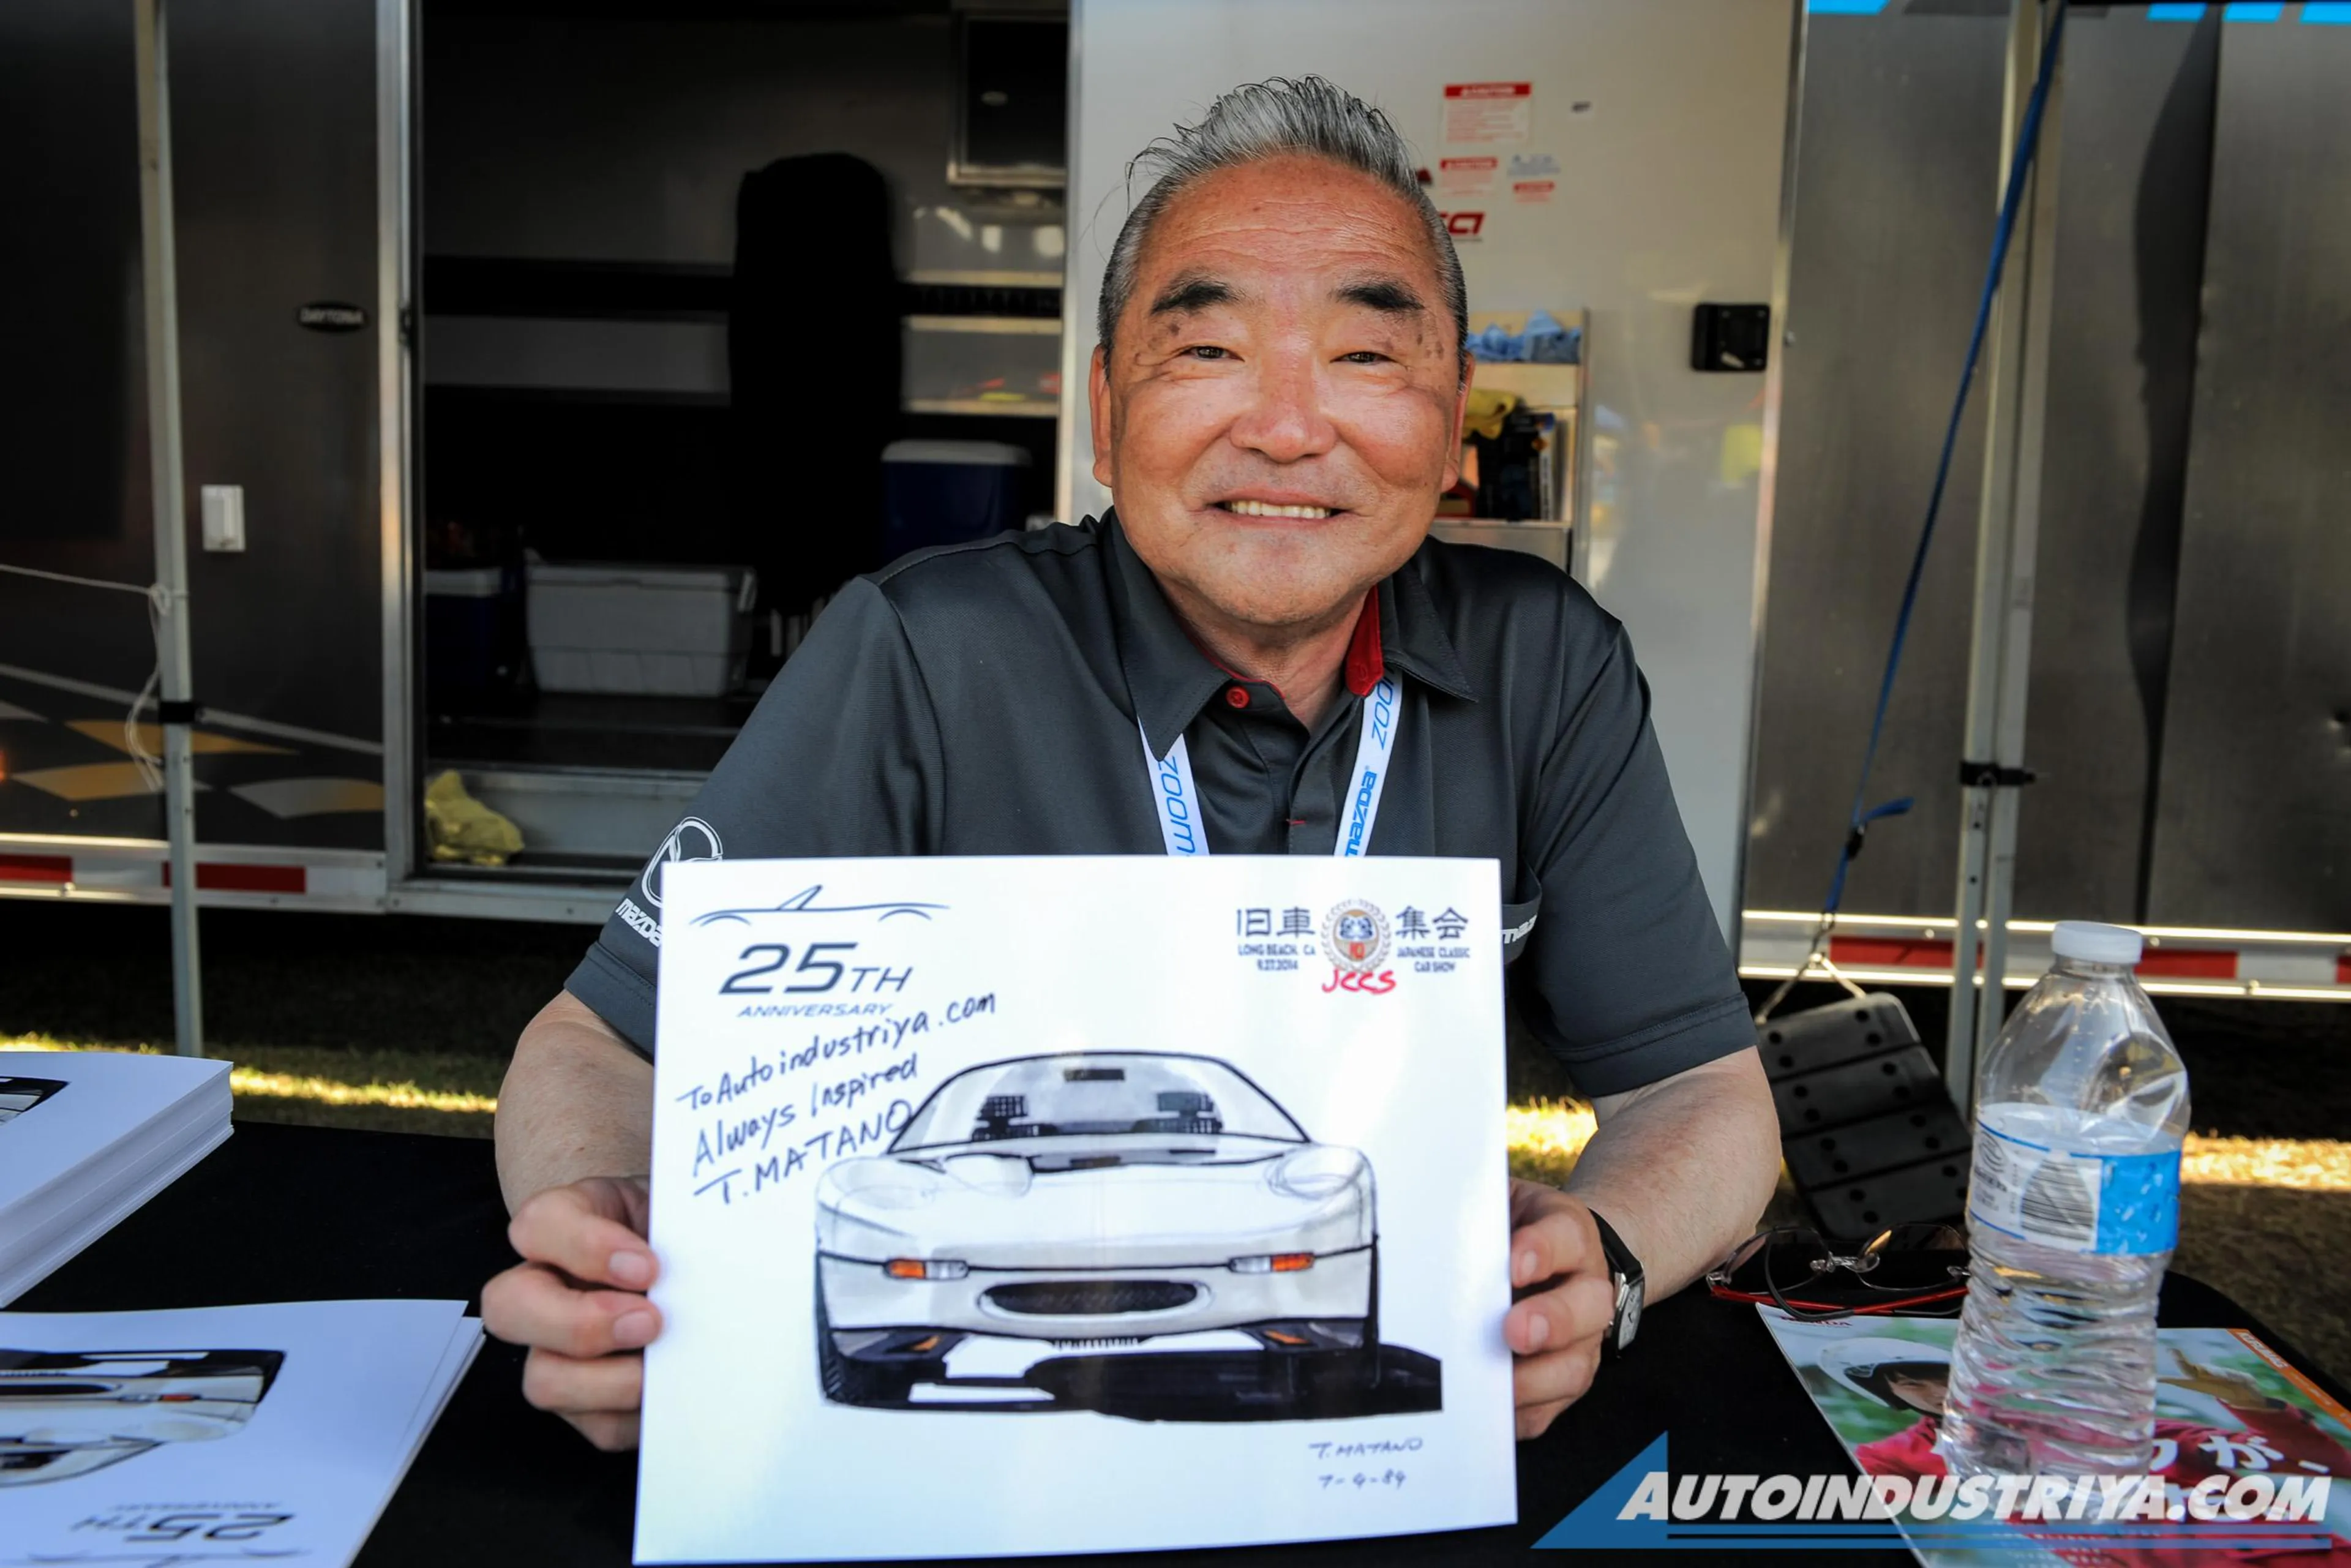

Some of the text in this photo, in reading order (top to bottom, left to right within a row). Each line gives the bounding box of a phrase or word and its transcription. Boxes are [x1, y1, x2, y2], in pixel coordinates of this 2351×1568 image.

[1236, 907, 1316, 938] 旧車
[1395, 906, 1468, 940] 集会
[719, 942, 913, 994] 25TH
[737, 1003, 892, 1018] ANNIVERSARY
[692, 1104, 797, 1178] Always
